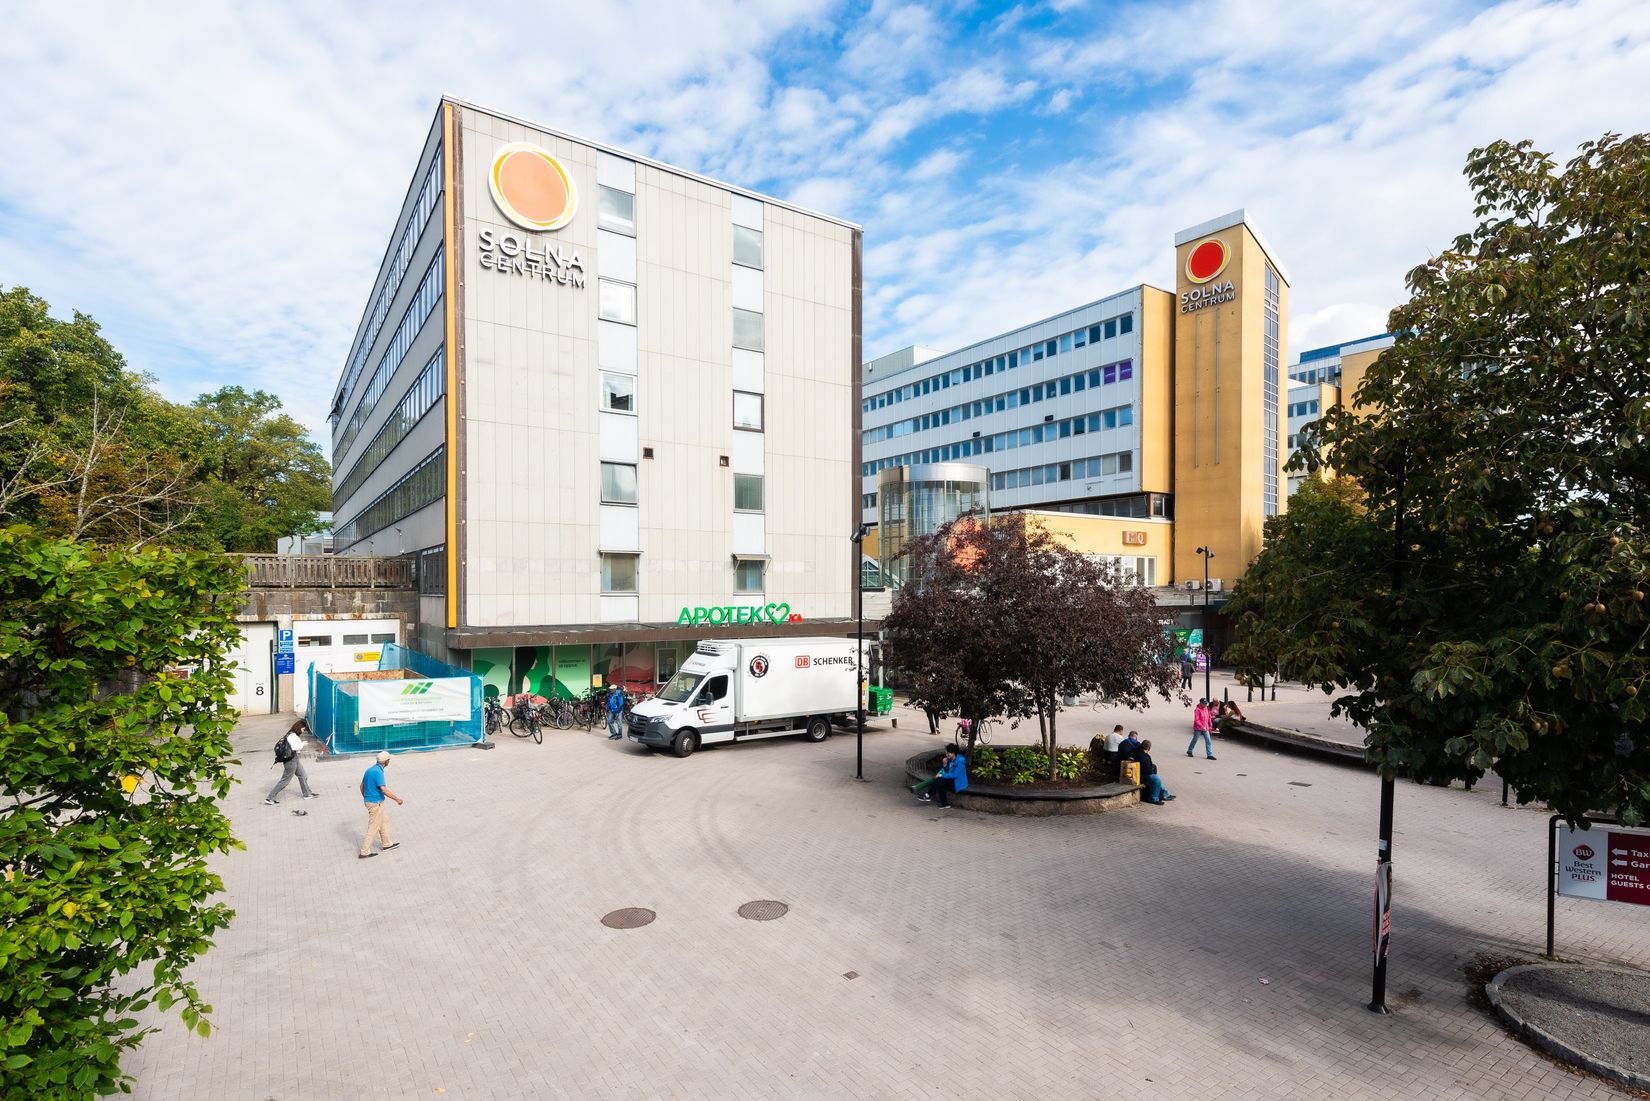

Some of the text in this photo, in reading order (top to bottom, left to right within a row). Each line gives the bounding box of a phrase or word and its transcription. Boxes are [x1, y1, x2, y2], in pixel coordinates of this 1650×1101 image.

[479, 227, 584, 272] SOLNA
[480, 252, 586, 288] CENTRUM
[1181, 280, 1234, 304] SOLNA
[1181, 291, 1235, 313] CENTRUM
[677, 606, 763, 625] APOTEK
[282, 631, 291, 641] P
[796, 656, 854, 667] DB SCHENKER
[256, 686, 264, 696] 8
[1575, 848, 1592, 857] BW
[1631, 850, 1650, 858] Tax
[1574, 861, 1594, 869] Best
[1565, 866, 1602, 876] Western
[1571, 873, 1596, 881] PLUS
[1611, 873, 1640, 881] HOTEL
[1610, 880, 1645, 889] GUESTS
